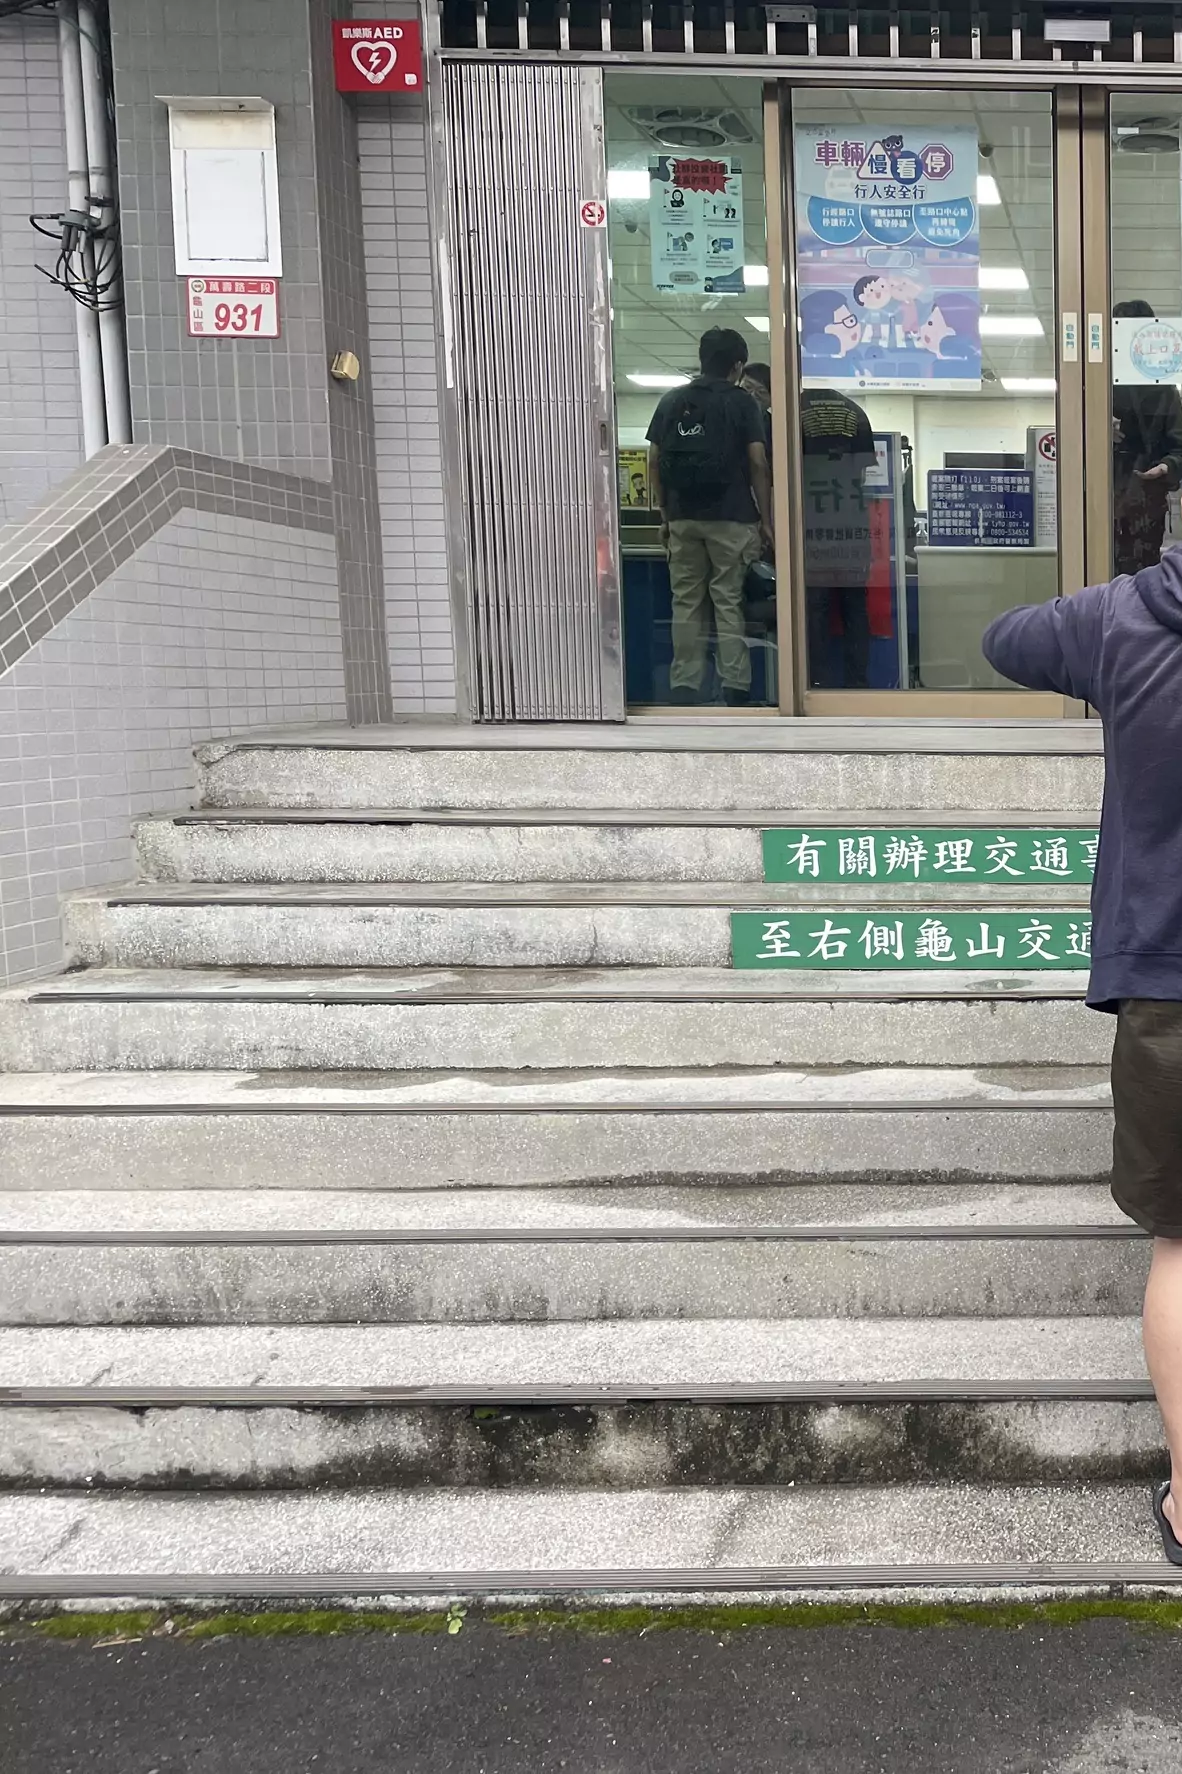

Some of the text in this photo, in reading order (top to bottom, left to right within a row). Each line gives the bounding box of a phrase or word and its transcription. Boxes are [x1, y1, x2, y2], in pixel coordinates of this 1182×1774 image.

[854, 184, 926, 199] 行人安全行
[209, 281, 271, 293] 萬壽路二段
[215, 303, 262, 331] 931
